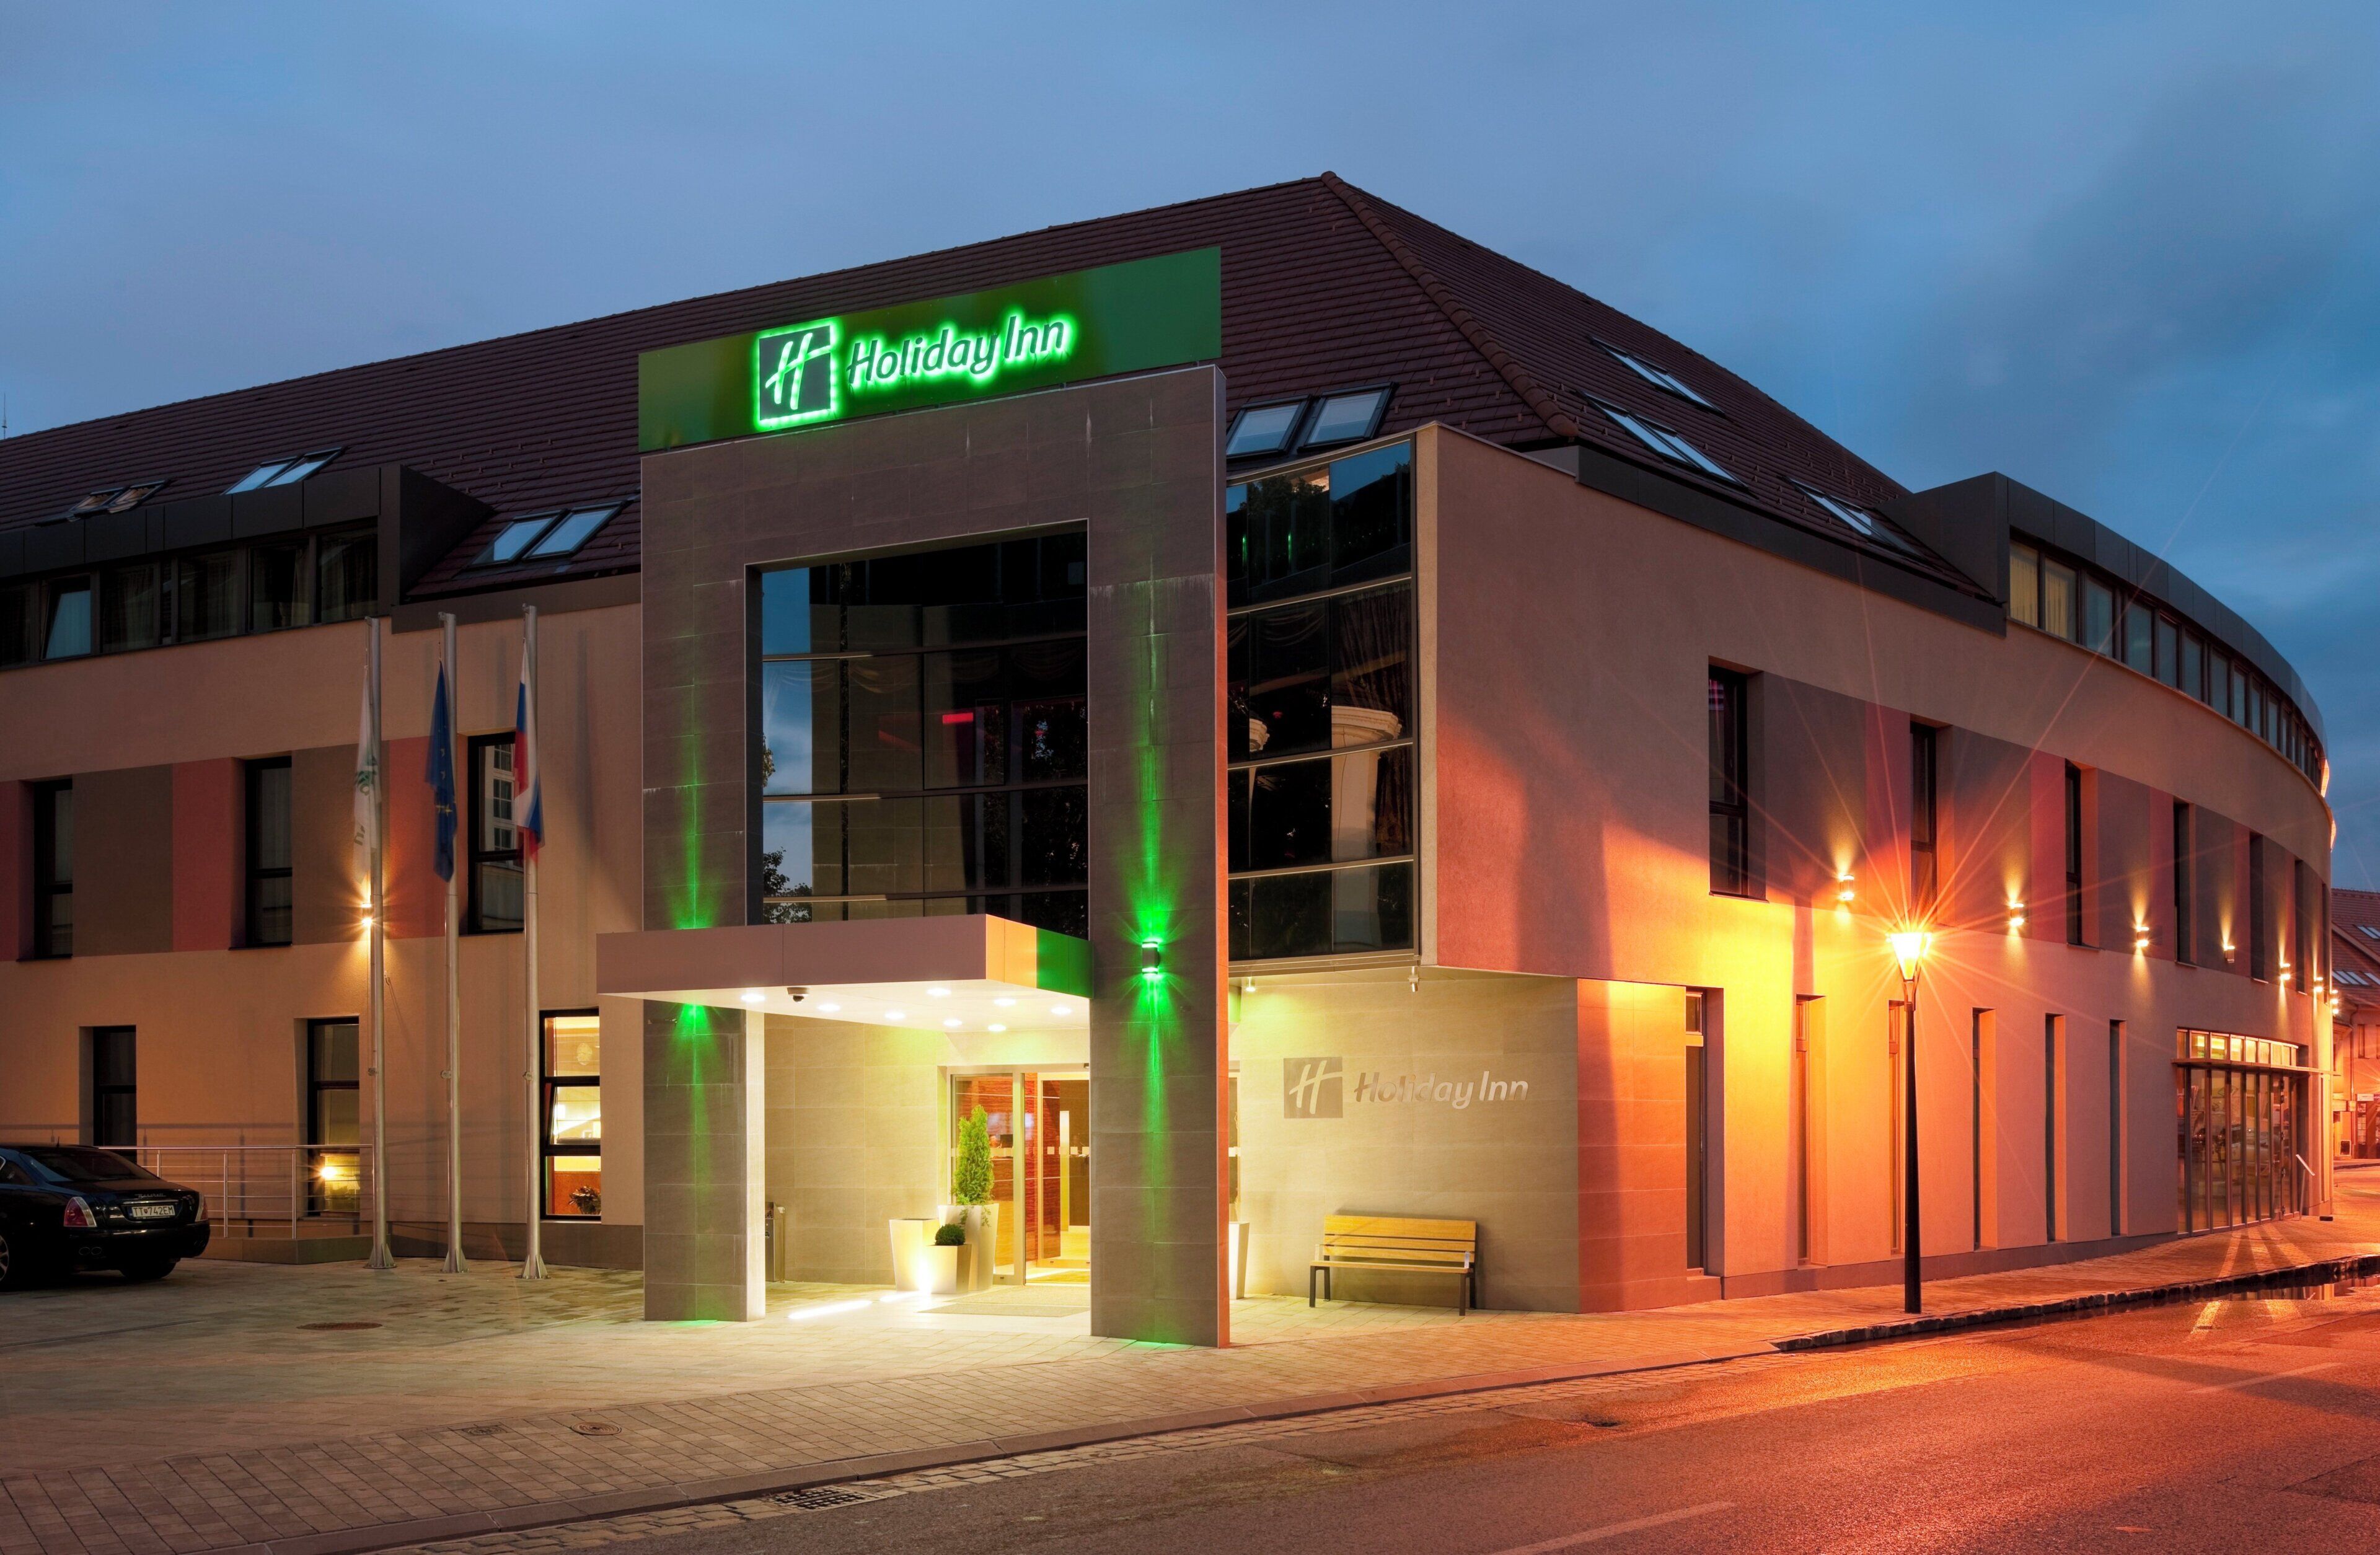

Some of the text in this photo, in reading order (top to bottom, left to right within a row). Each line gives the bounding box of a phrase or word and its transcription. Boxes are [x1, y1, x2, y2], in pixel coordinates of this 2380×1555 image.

[846, 315, 1064, 384] Holiday Inn
[1354, 1070, 1529, 1109] Holiday Inn
[133, 1207, 143, 1216] TT
[148, 1206, 174, 1215] 742EM
